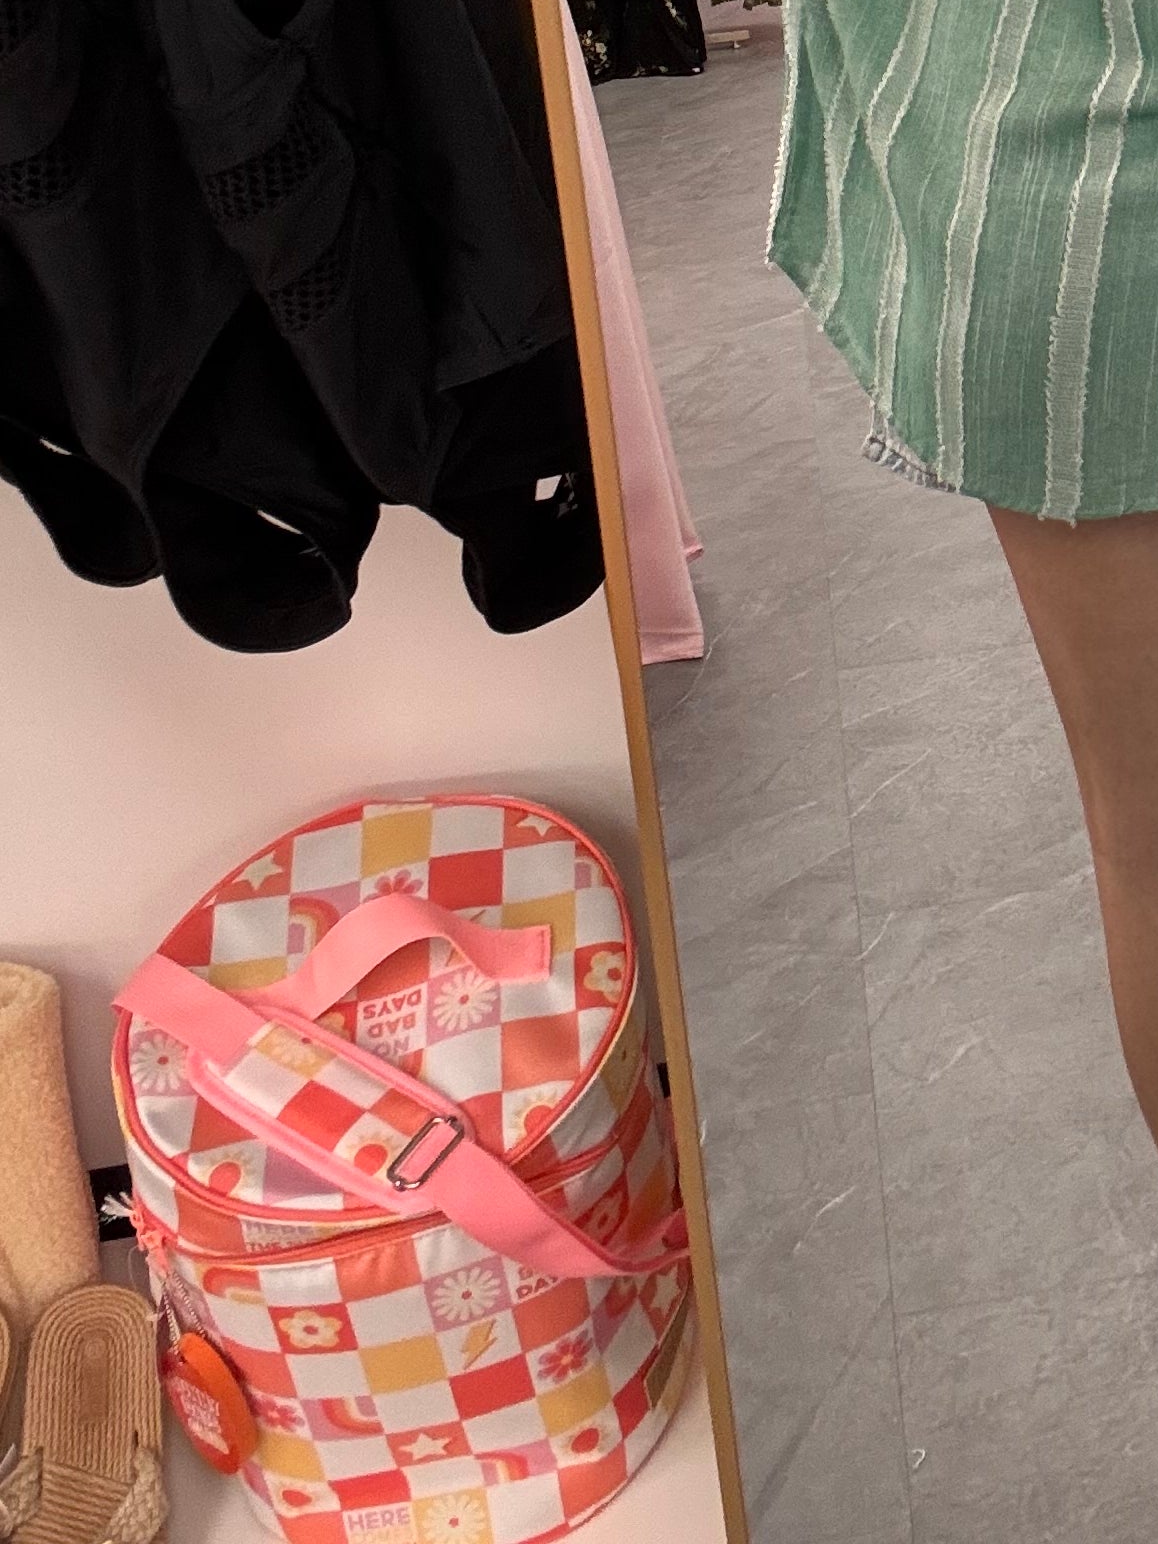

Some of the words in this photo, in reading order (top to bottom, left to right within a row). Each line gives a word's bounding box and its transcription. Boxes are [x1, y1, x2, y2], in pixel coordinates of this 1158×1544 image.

[363, 989, 421, 1019] DAYS
[368, 1012, 416, 1038] BAD
[347, 1506, 410, 1531] HERE
